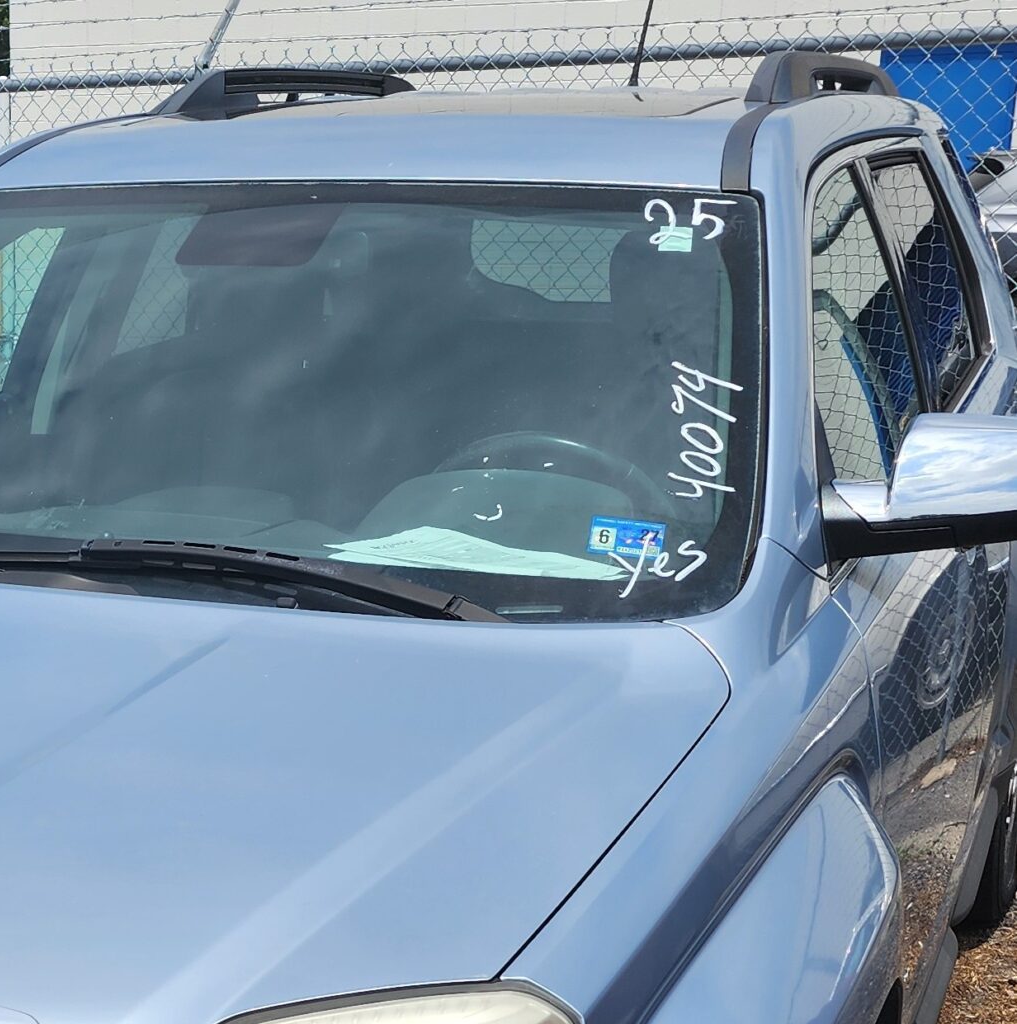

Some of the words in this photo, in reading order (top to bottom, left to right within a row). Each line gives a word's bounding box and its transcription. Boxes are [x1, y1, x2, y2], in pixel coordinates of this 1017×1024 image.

[644, 198, 738, 245] 25
[667, 360, 744, 499] 40074
[598, 528, 610, 545] 6
